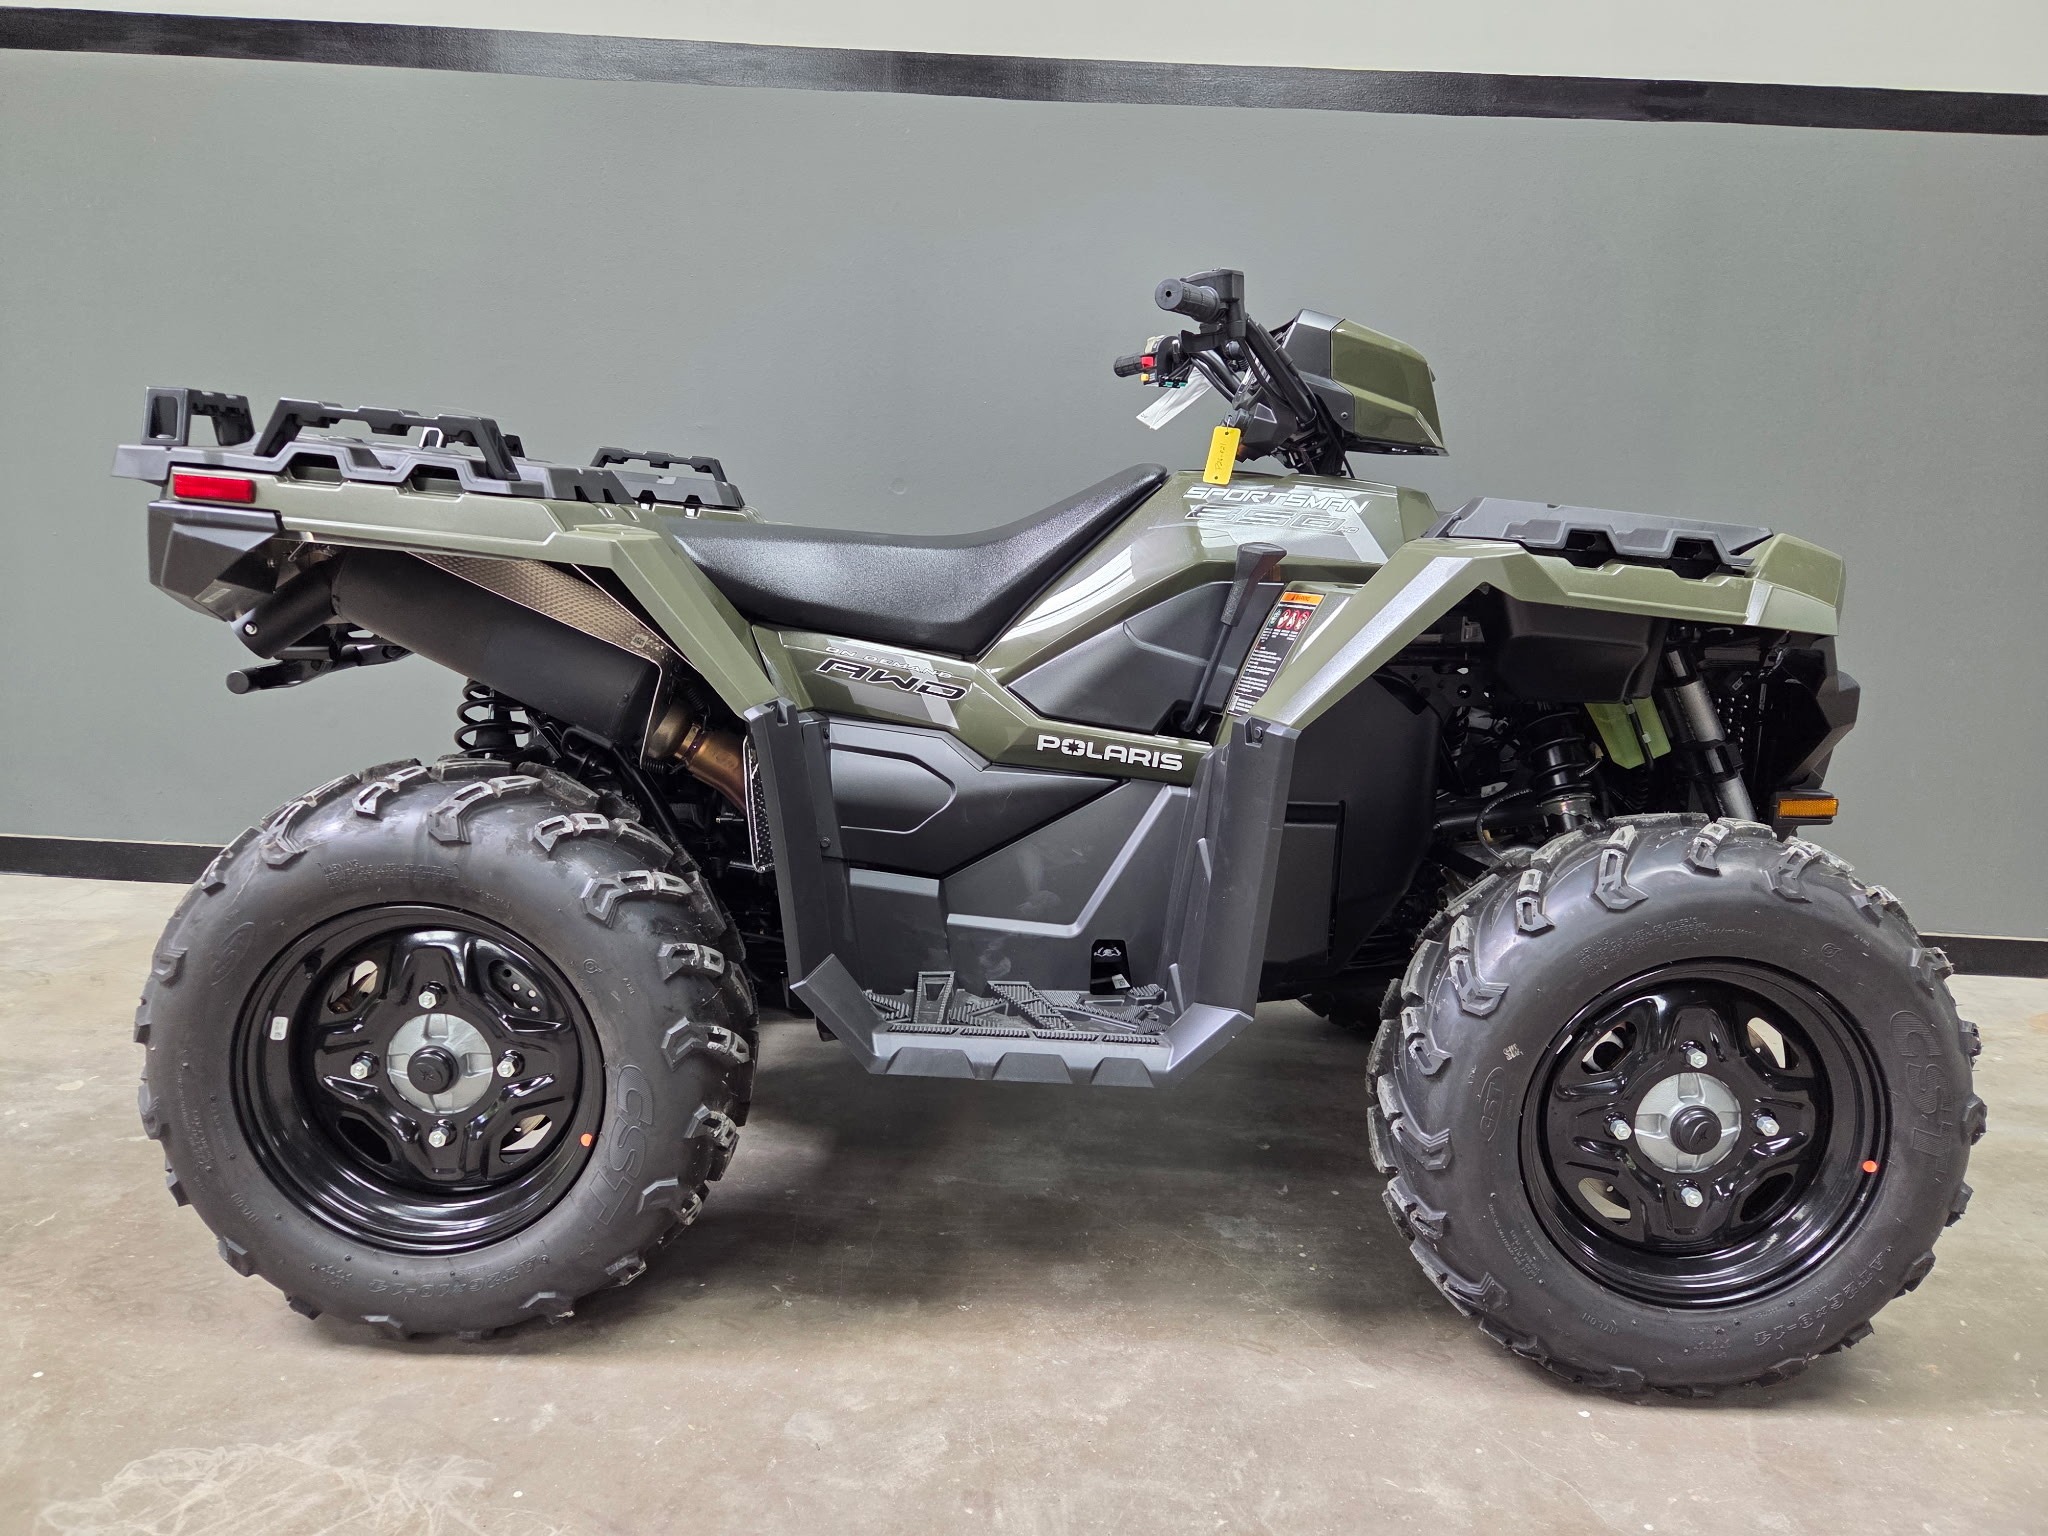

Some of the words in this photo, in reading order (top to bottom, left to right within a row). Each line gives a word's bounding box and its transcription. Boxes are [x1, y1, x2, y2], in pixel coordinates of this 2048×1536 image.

[1182, 486, 1371, 514] SPORTSMAN
[815, 658, 968, 701] AWD
[825, 646, 858, 657] ON
[863, 655, 953, 678] DEMAND
[1036, 734, 1184, 772] POLARIS
[1890, 1010, 1954, 1174] CST
[589, 1064, 654, 1225] CST
